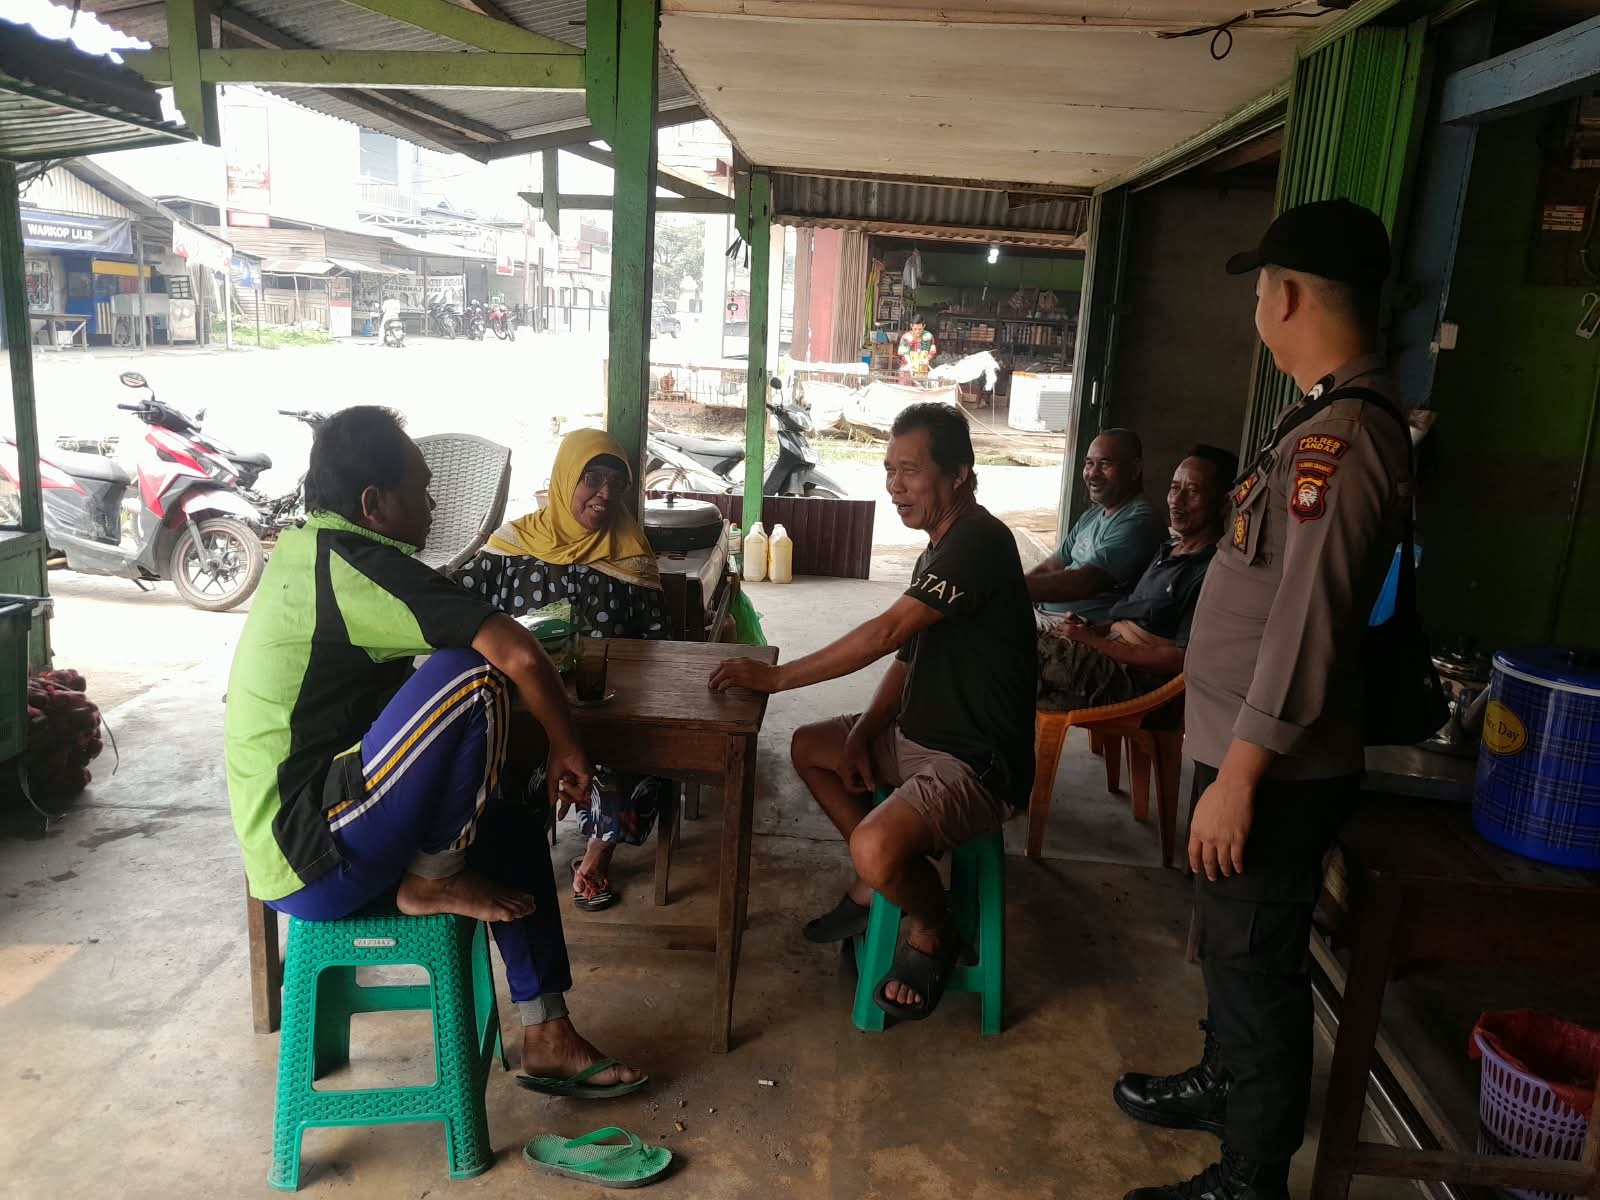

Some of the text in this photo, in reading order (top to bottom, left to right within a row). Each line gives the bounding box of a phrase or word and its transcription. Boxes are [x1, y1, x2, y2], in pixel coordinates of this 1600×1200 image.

[27, 223, 94, 241] WARKOP LILIS
[1300, 436, 1341, 449] POLRES
[1498, 720, 1520, 741] Day
